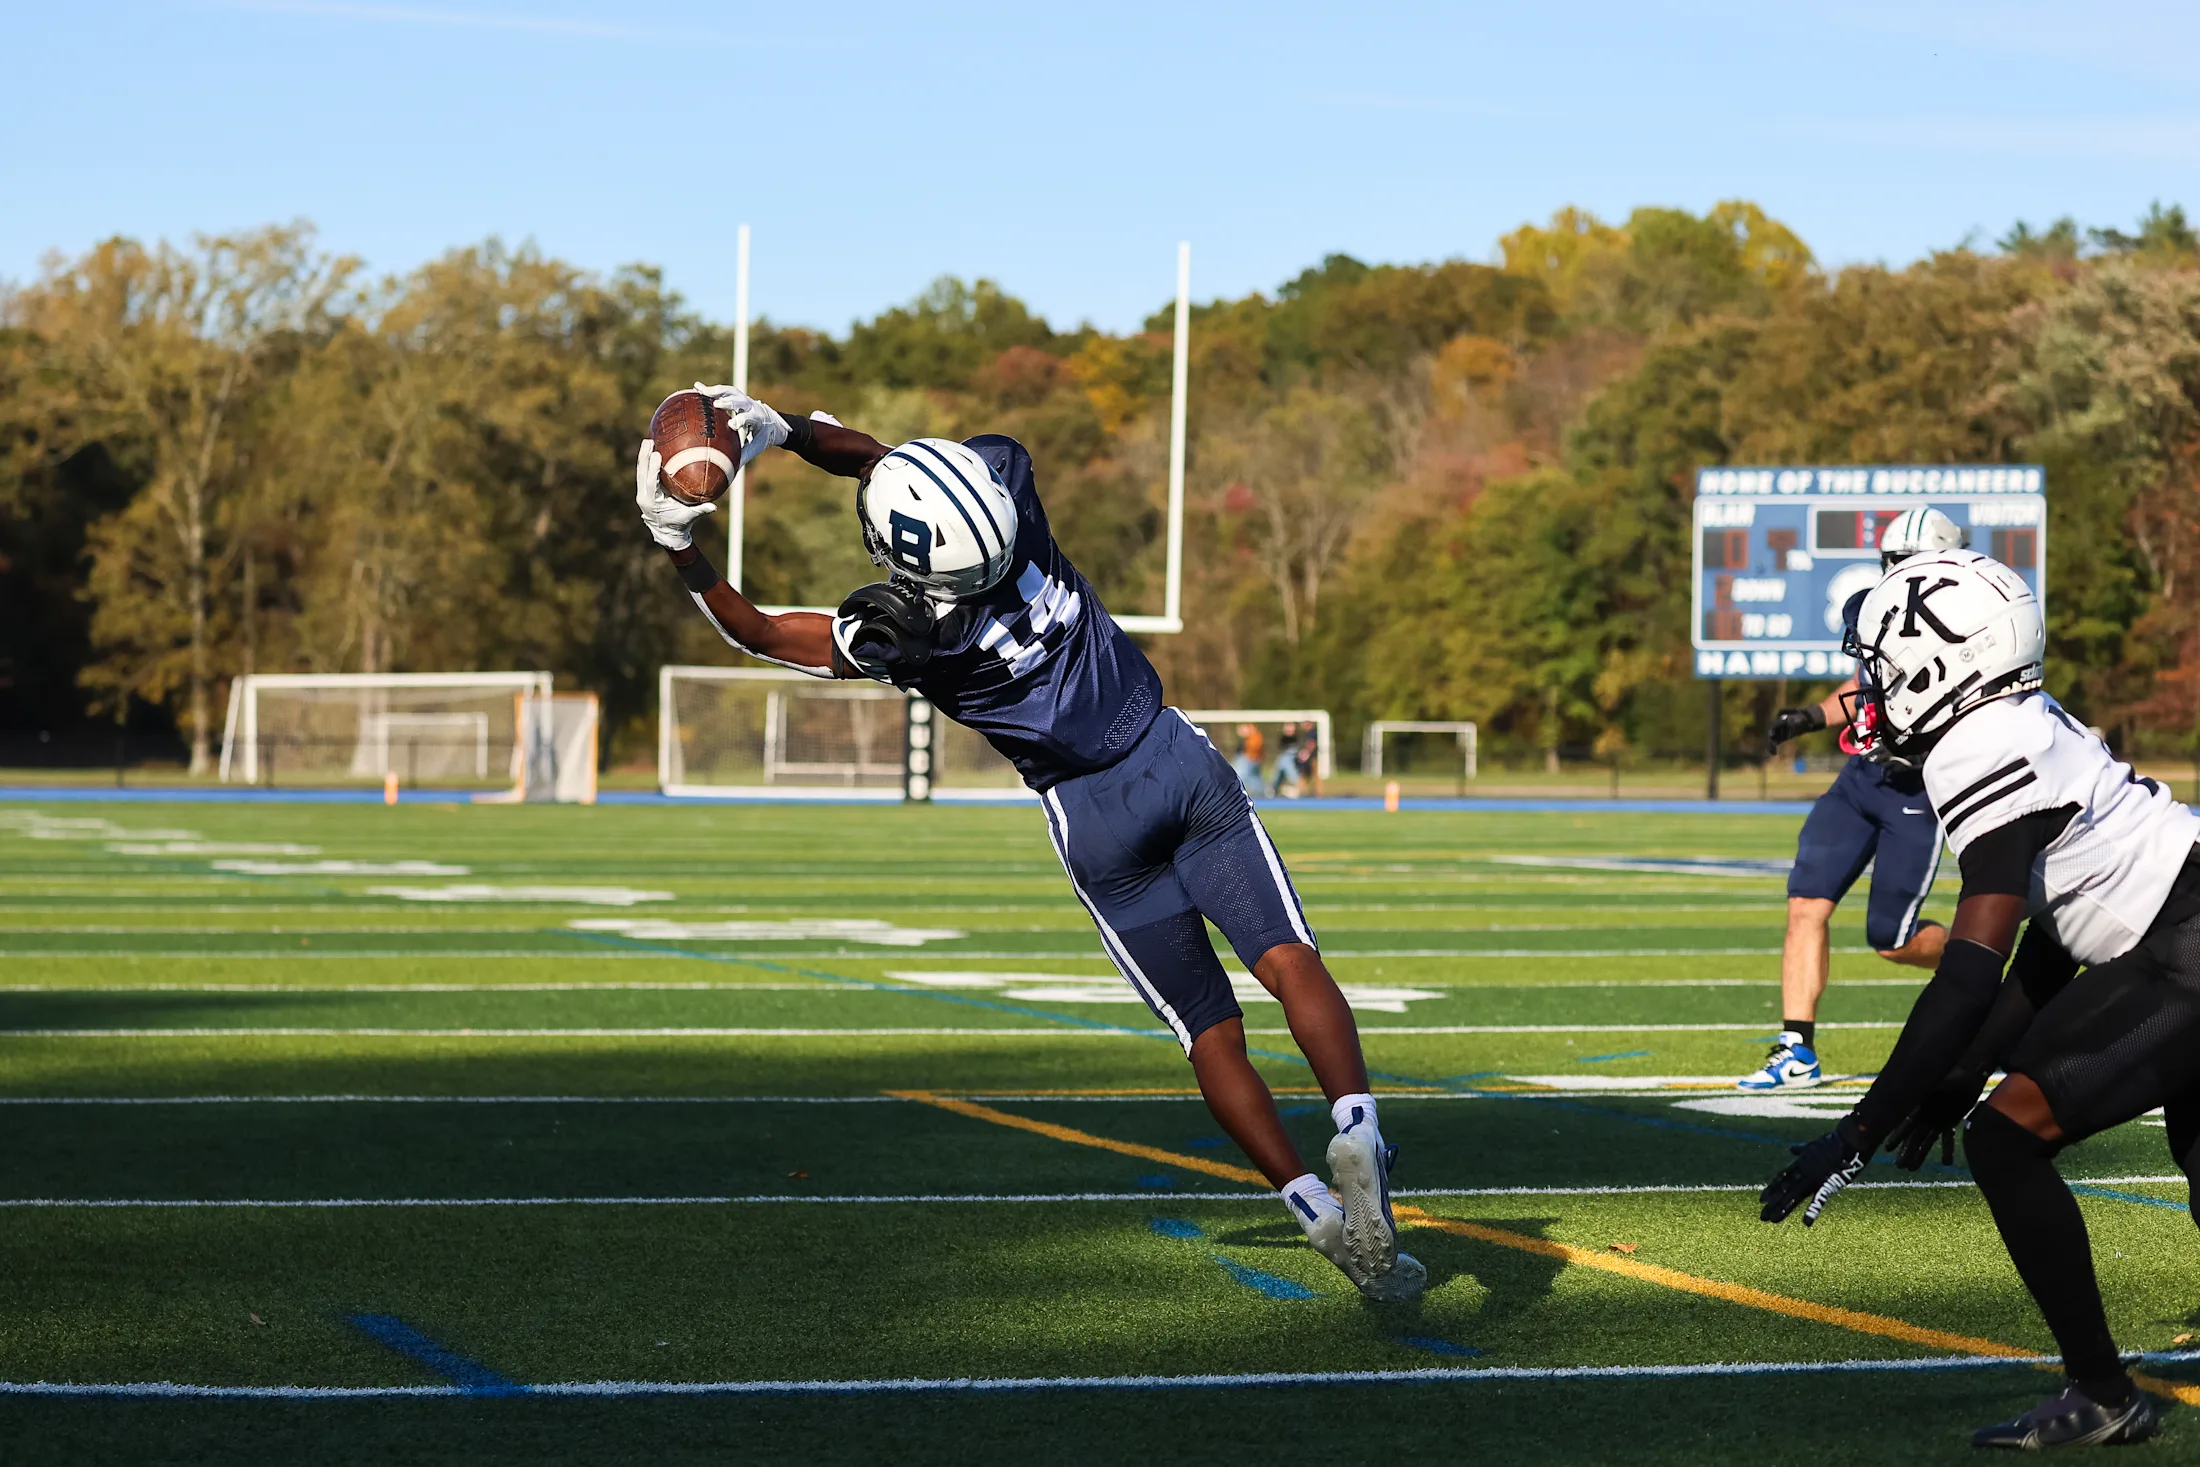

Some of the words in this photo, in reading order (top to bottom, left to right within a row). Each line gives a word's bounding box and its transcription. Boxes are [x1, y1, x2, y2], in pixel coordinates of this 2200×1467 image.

[1700, 470, 1773, 493] HOME
[1777, 470, 1812, 493] OF
[1818, 470, 1867, 493] THE
[1872, 469, 2040, 493] BUCCANEERS
[889, 508, 932, 576] B
[1899, 576, 1968, 643] K
[1699, 652, 1857, 674] HAMPSH
